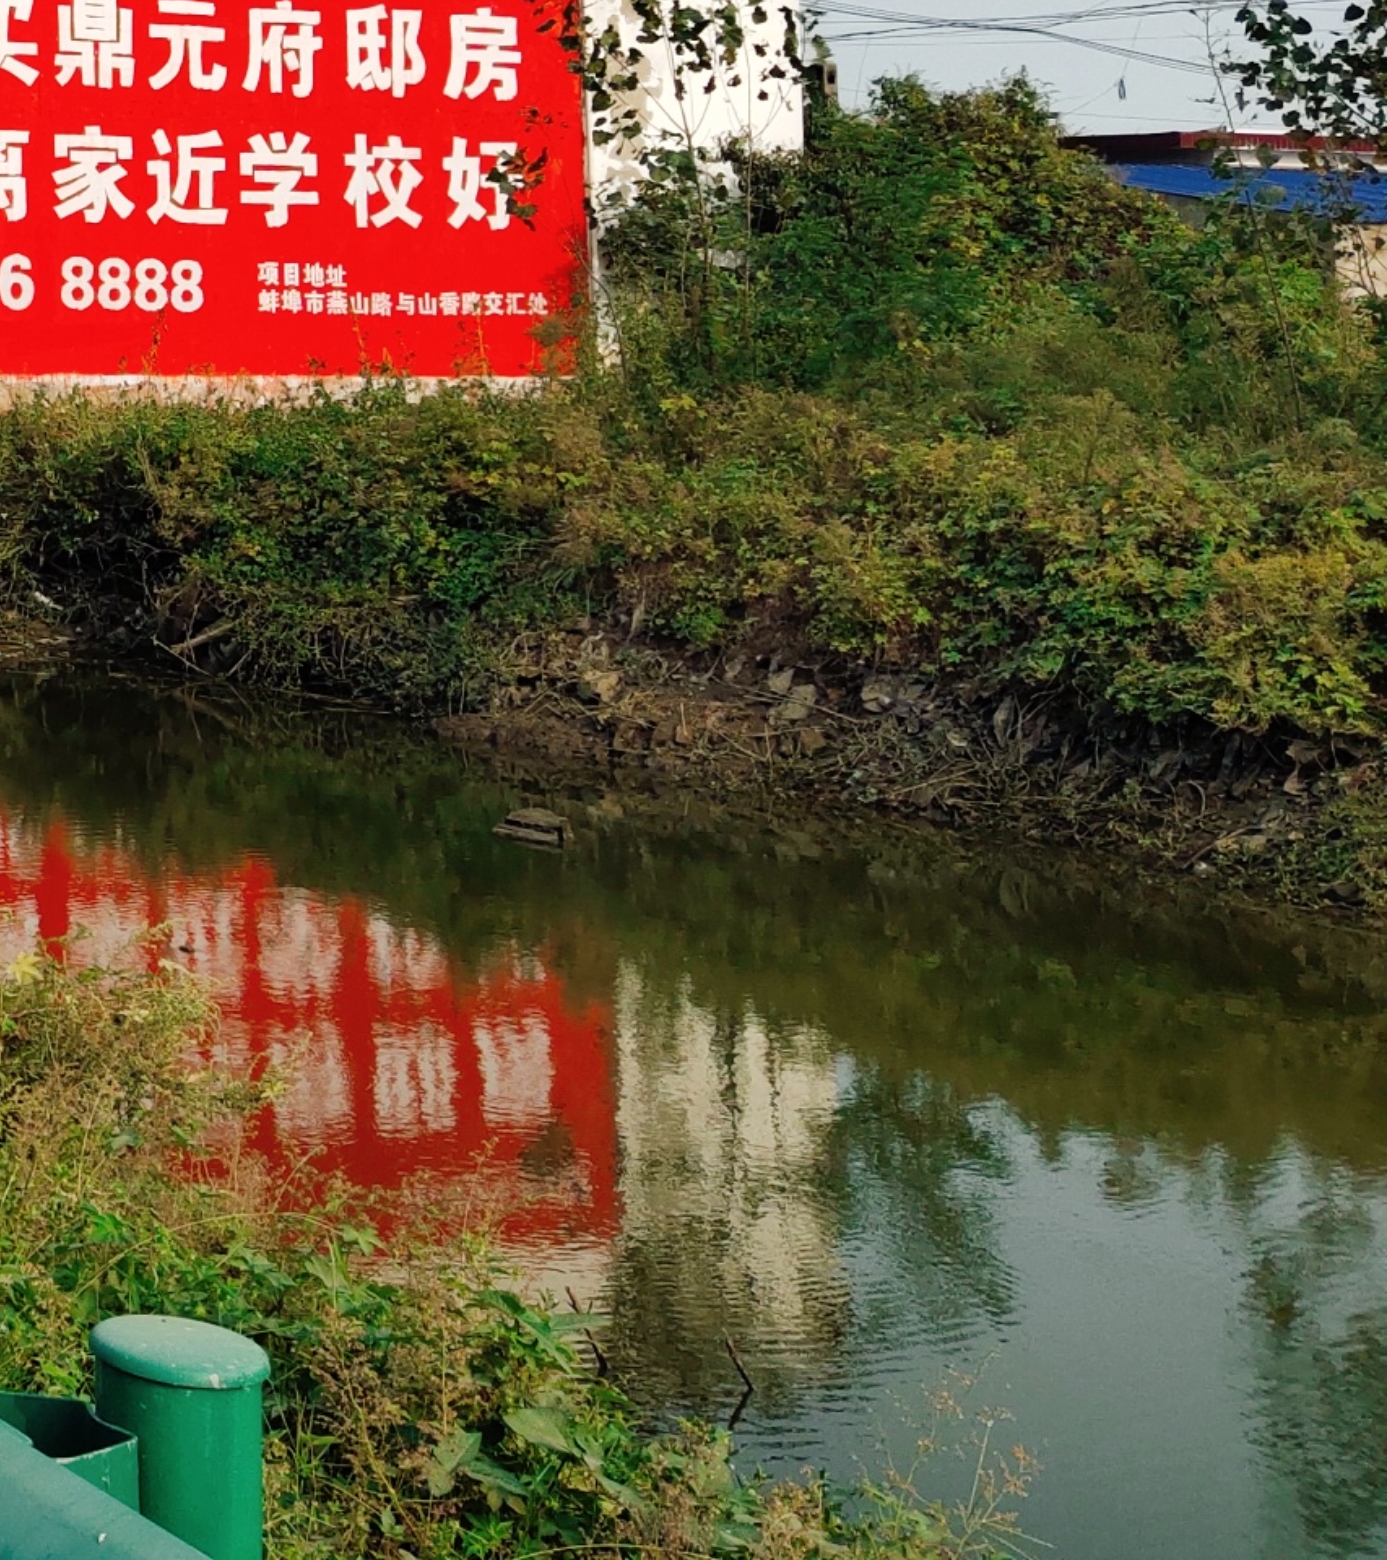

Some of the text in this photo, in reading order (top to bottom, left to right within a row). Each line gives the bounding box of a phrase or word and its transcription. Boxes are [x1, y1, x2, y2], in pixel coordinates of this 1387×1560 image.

[60, 256, 204, 313] 8888
[257, 261, 348, 288] 项目地址
